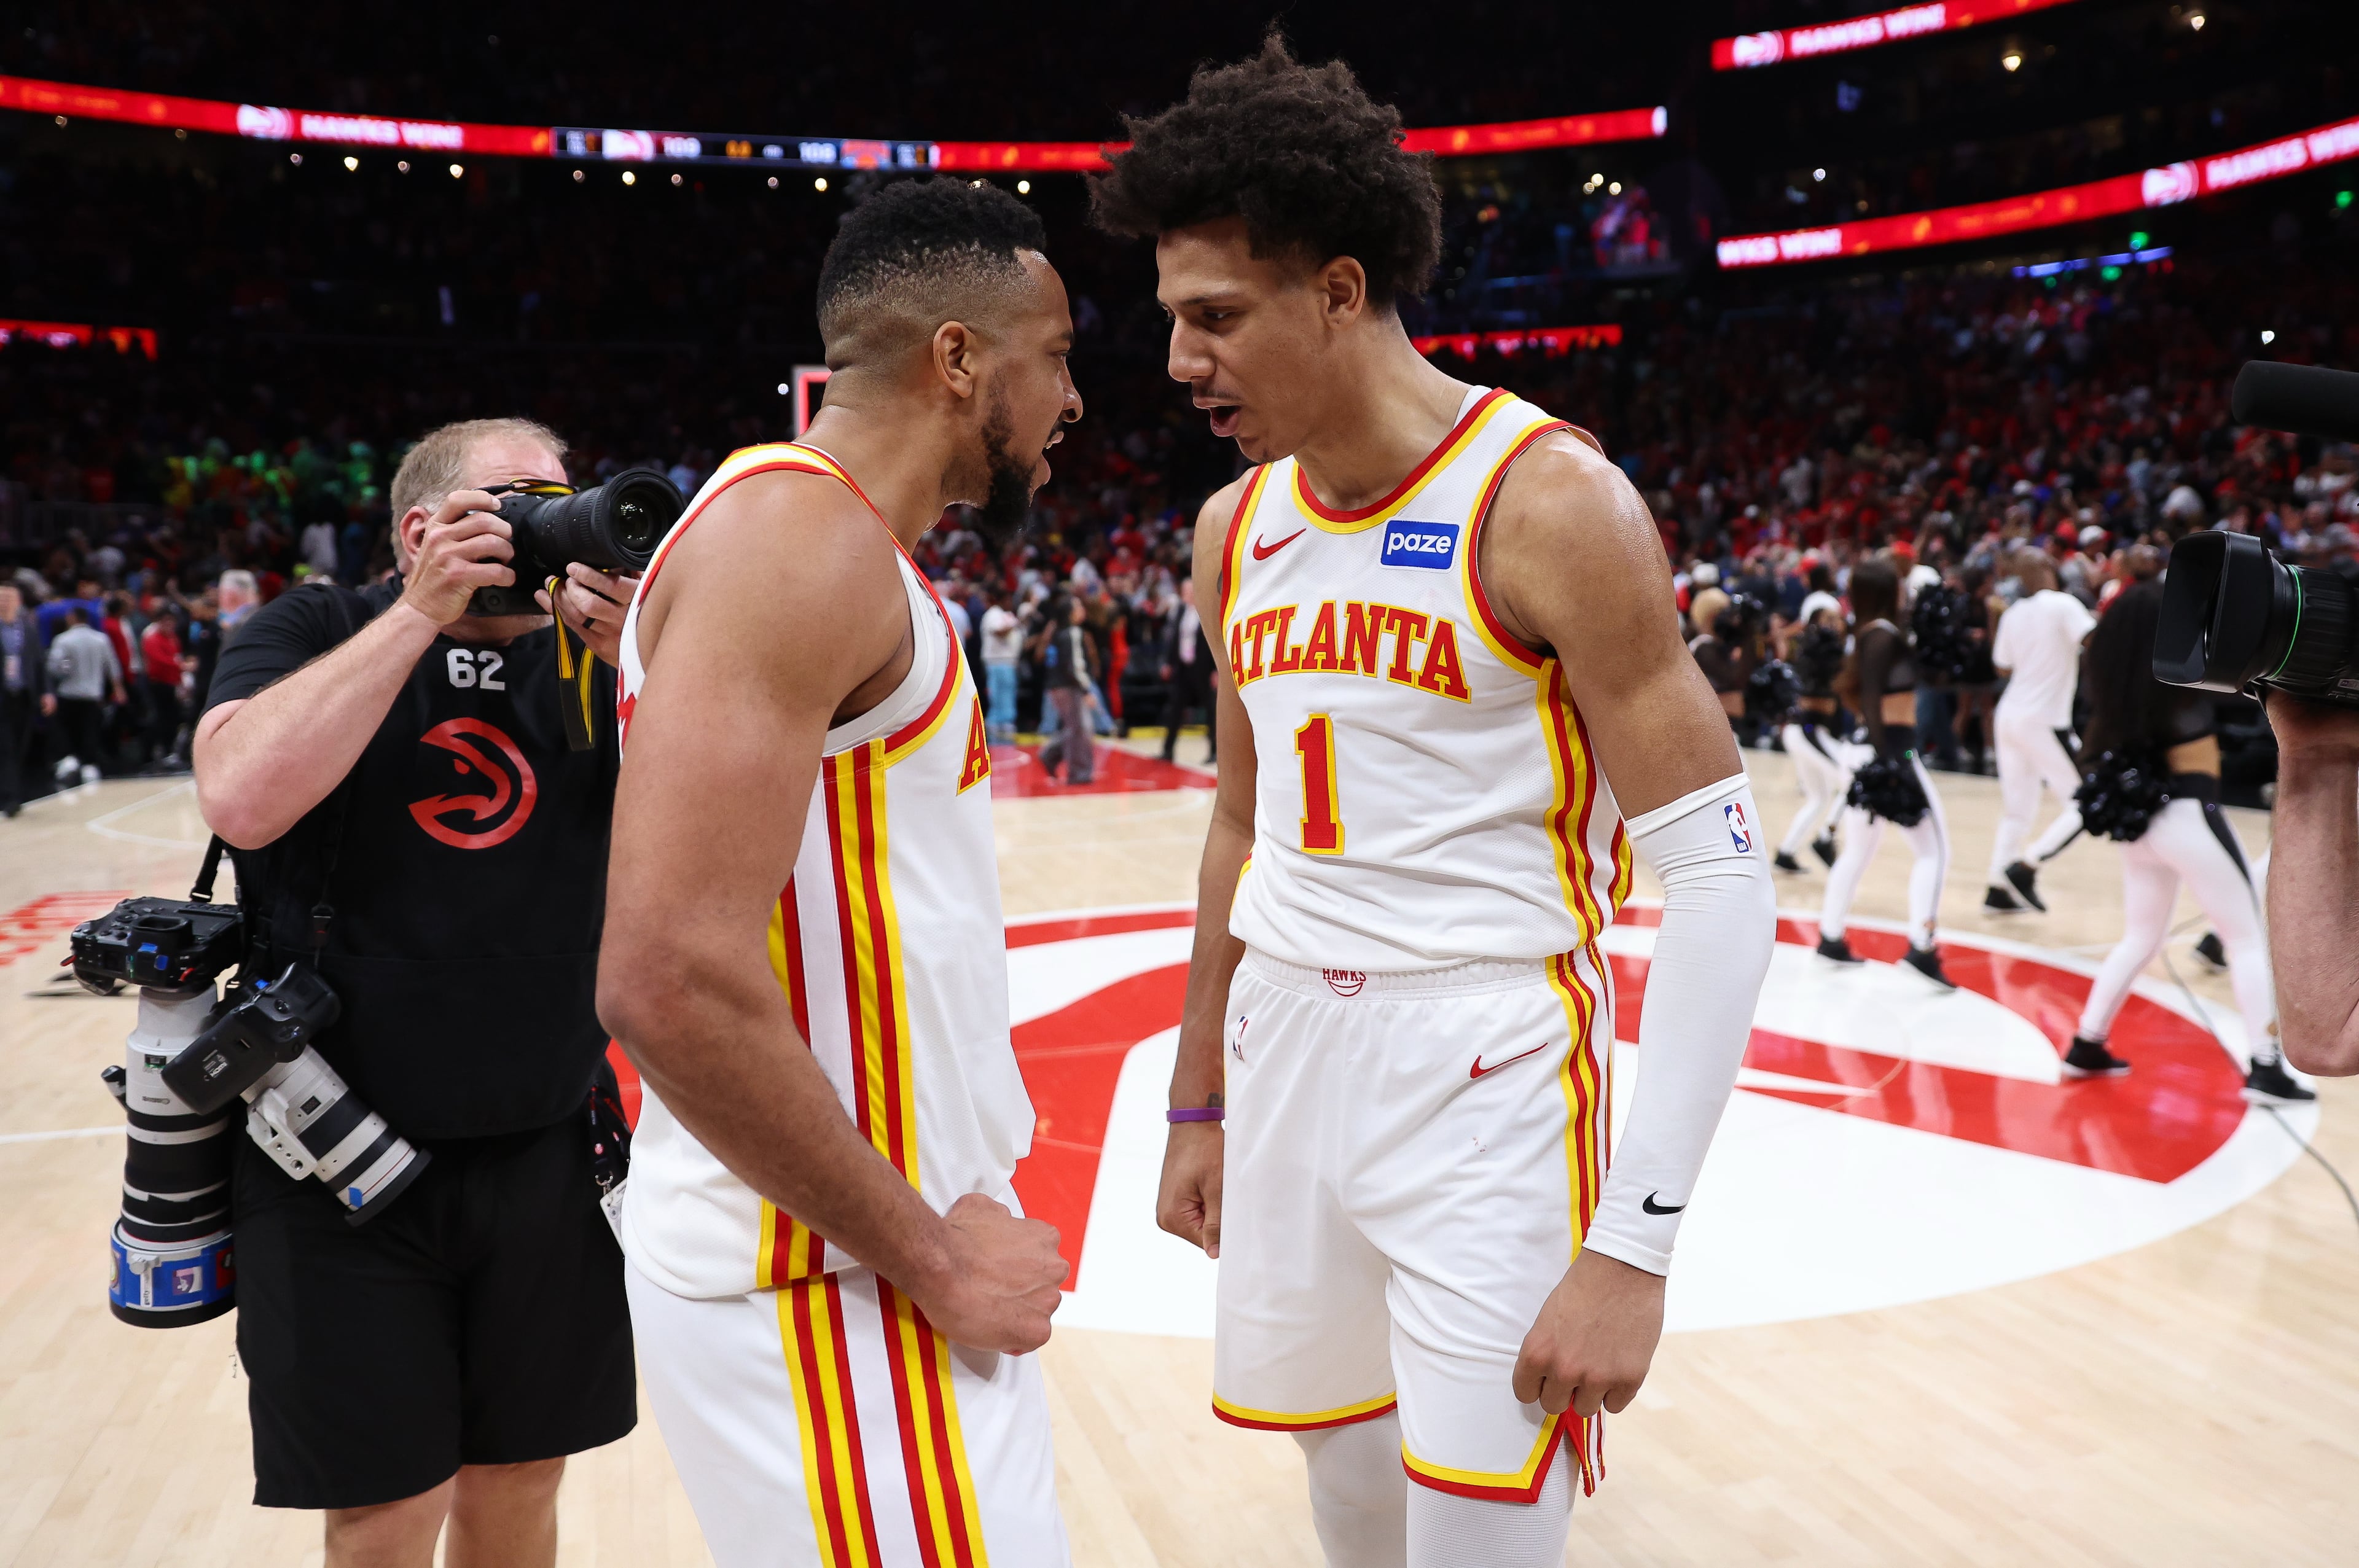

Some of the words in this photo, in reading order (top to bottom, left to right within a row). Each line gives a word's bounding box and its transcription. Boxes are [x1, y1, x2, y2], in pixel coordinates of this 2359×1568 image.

[1386, 532, 1452, 555] paze
[1230, 599, 1472, 703] ATLANTA
[446, 648, 506, 691] 62
[1294, 712, 1345, 856] 1
[1737, 841, 1748, 851] NBA
[1322, 968, 1367, 981] HAWKS
